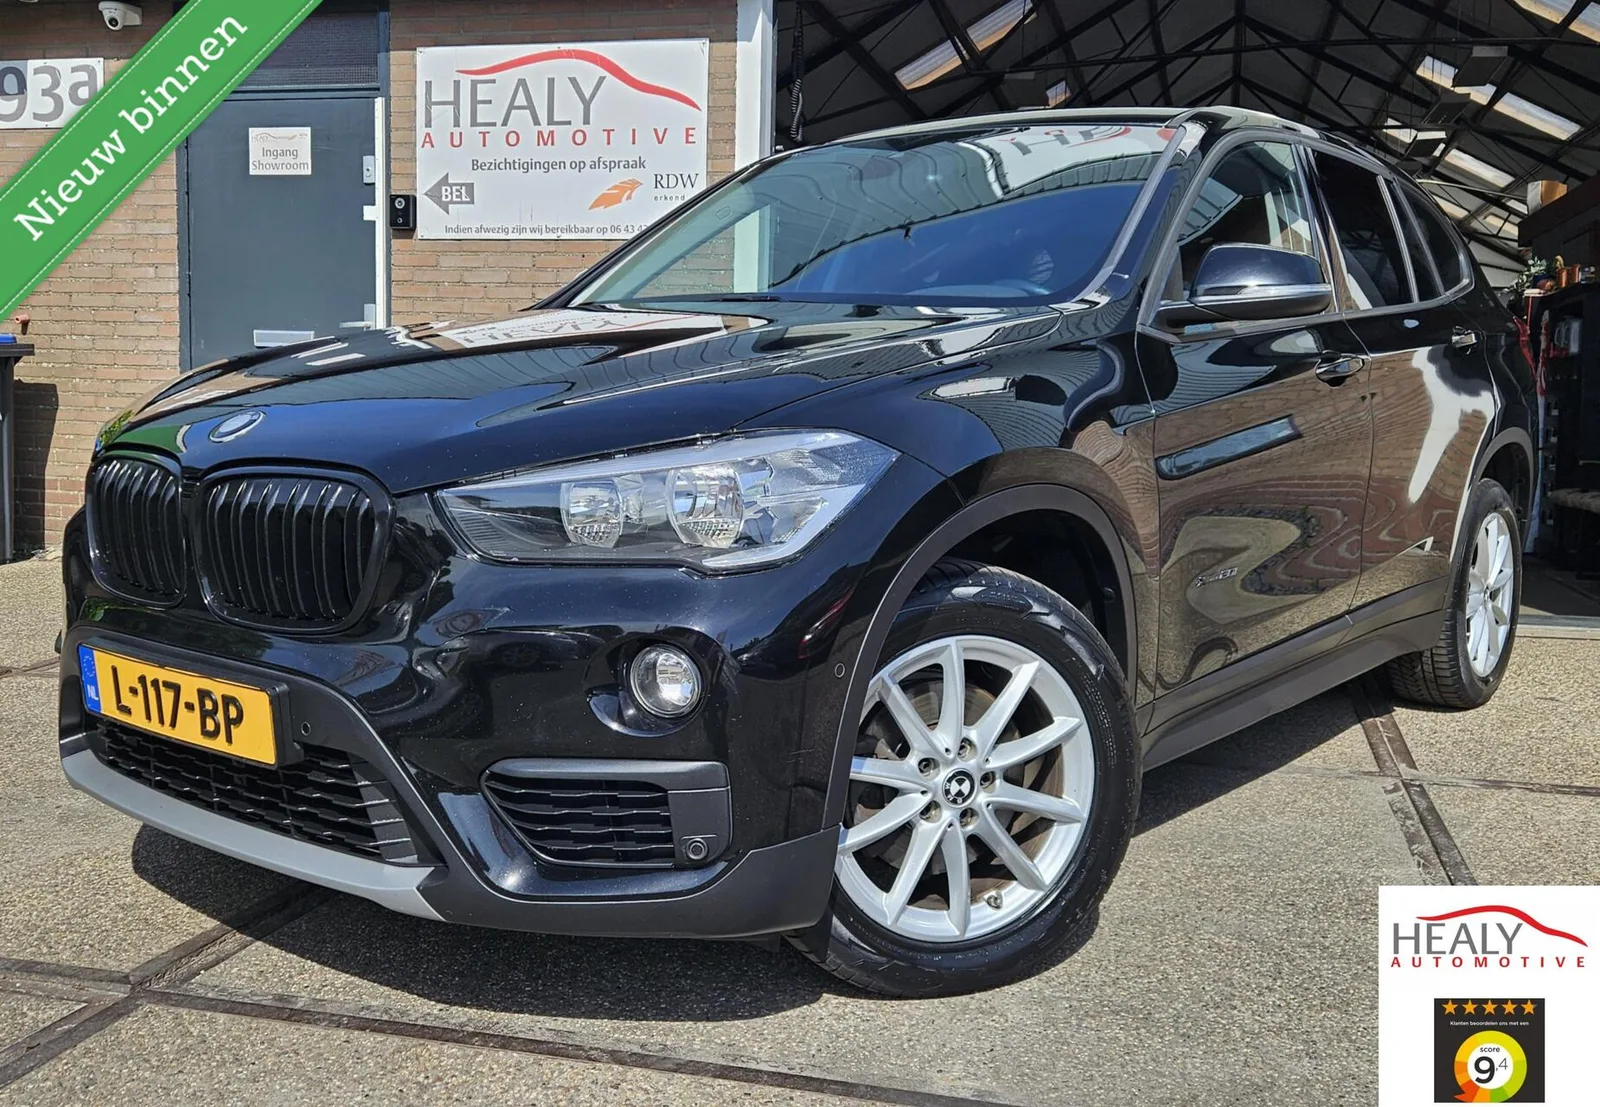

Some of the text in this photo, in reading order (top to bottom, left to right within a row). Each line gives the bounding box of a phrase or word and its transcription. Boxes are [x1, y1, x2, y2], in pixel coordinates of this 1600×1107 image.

[424, 75, 607, 128] HEALY
[421, 127, 696, 148] AUTOMOTIVE
[262, 147, 298, 160] Ingang
[251, 160, 309, 171] Showroom
[471, 156, 647, 173] Bezichtigingen op afspraak
[653, 173, 700, 189] RDW
[441, 186, 471, 201] BEL
[444, 224, 473, 234] Indien
[474, 224, 509, 236] afwezig
[511, 225, 528, 235] zijn
[529, 225, 544, 235] wij
[545, 224, 595, 234] bereikbaar
[596, 227, 608, 235] op
[610, 224, 622, 234] 06
[623, 224, 635, 234] 43
[86, 684, 100, 701] NL
[110, 664, 244, 745] L-117-BP
